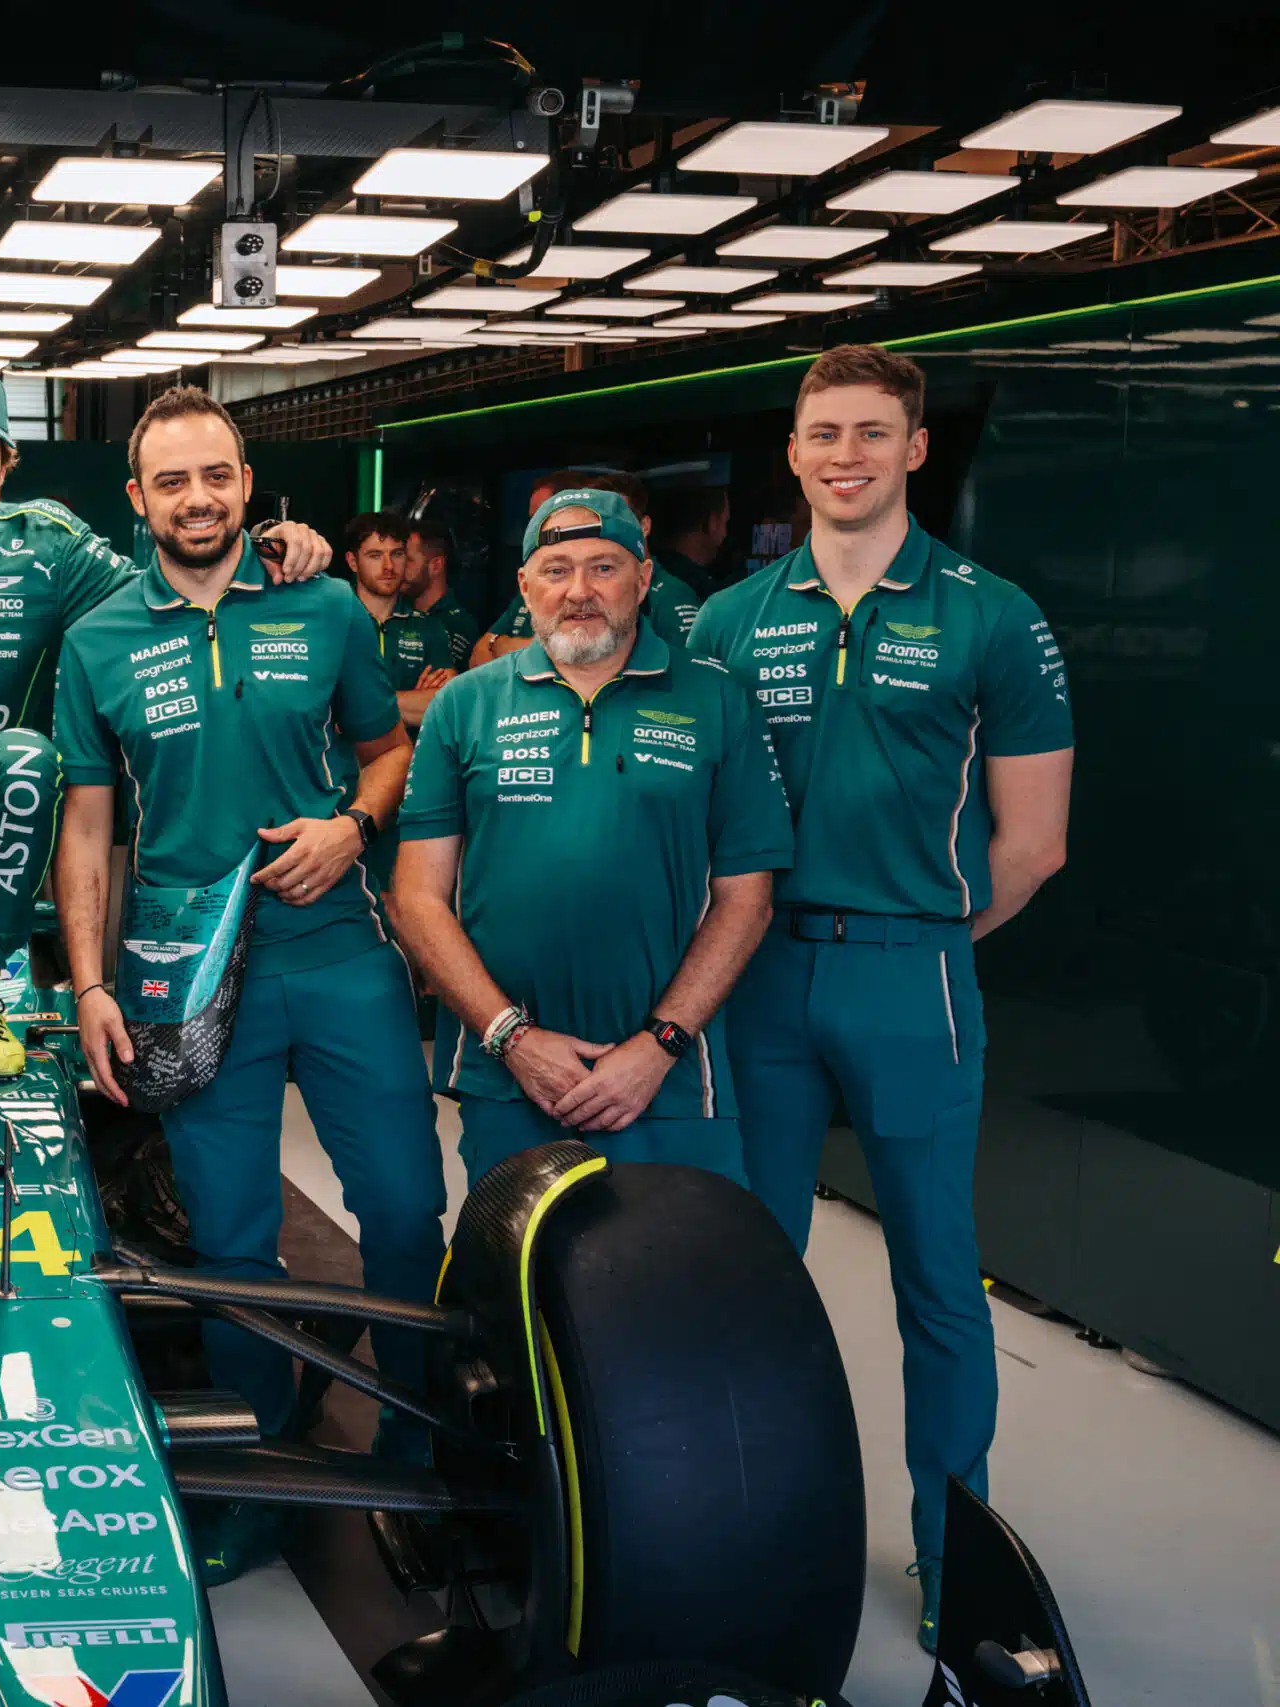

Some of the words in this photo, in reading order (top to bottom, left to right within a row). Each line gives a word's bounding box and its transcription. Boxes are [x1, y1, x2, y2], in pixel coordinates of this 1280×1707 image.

[754, 622, 818, 639] MAADEN
[129, 635, 190, 664] MAADEN
[251, 643, 308, 654] aramco
[753, 640, 816, 659] cognizant
[877, 642, 939, 660] aramco
[134, 653, 193, 680] cognizant
[875, 655, 903, 664] FORMULA
[271, 671, 308, 682] Valvoline
[759, 664, 807, 681] BOSS
[145, 676, 189, 700] BOSS
[888, 677, 930, 691] Valvoline
[146, 696, 197, 723] JCB
[497, 709, 560, 728] MAADEN
[151, 721, 201, 740] SentinelOne
[496, 726, 560, 744] cognizant
[634, 728, 696, 746] aramco
[502, 746, 550, 760] BOSS
[653, 756, 694, 772] Valvoline
[499, 768, 552, 784] JCB
[497, 793, 553, 803] SentinelOne
[142, 944, 158, 952] ASTON
[159, 945, 180, 953] MARTIN
[0, 1588, 51, 1600] SEVEN
[57, 1587, 96, 1598] SEAS
[101, 1585, 168, 1597] CRUISES
[4, 1618, 179, 1648] PIRELLI
